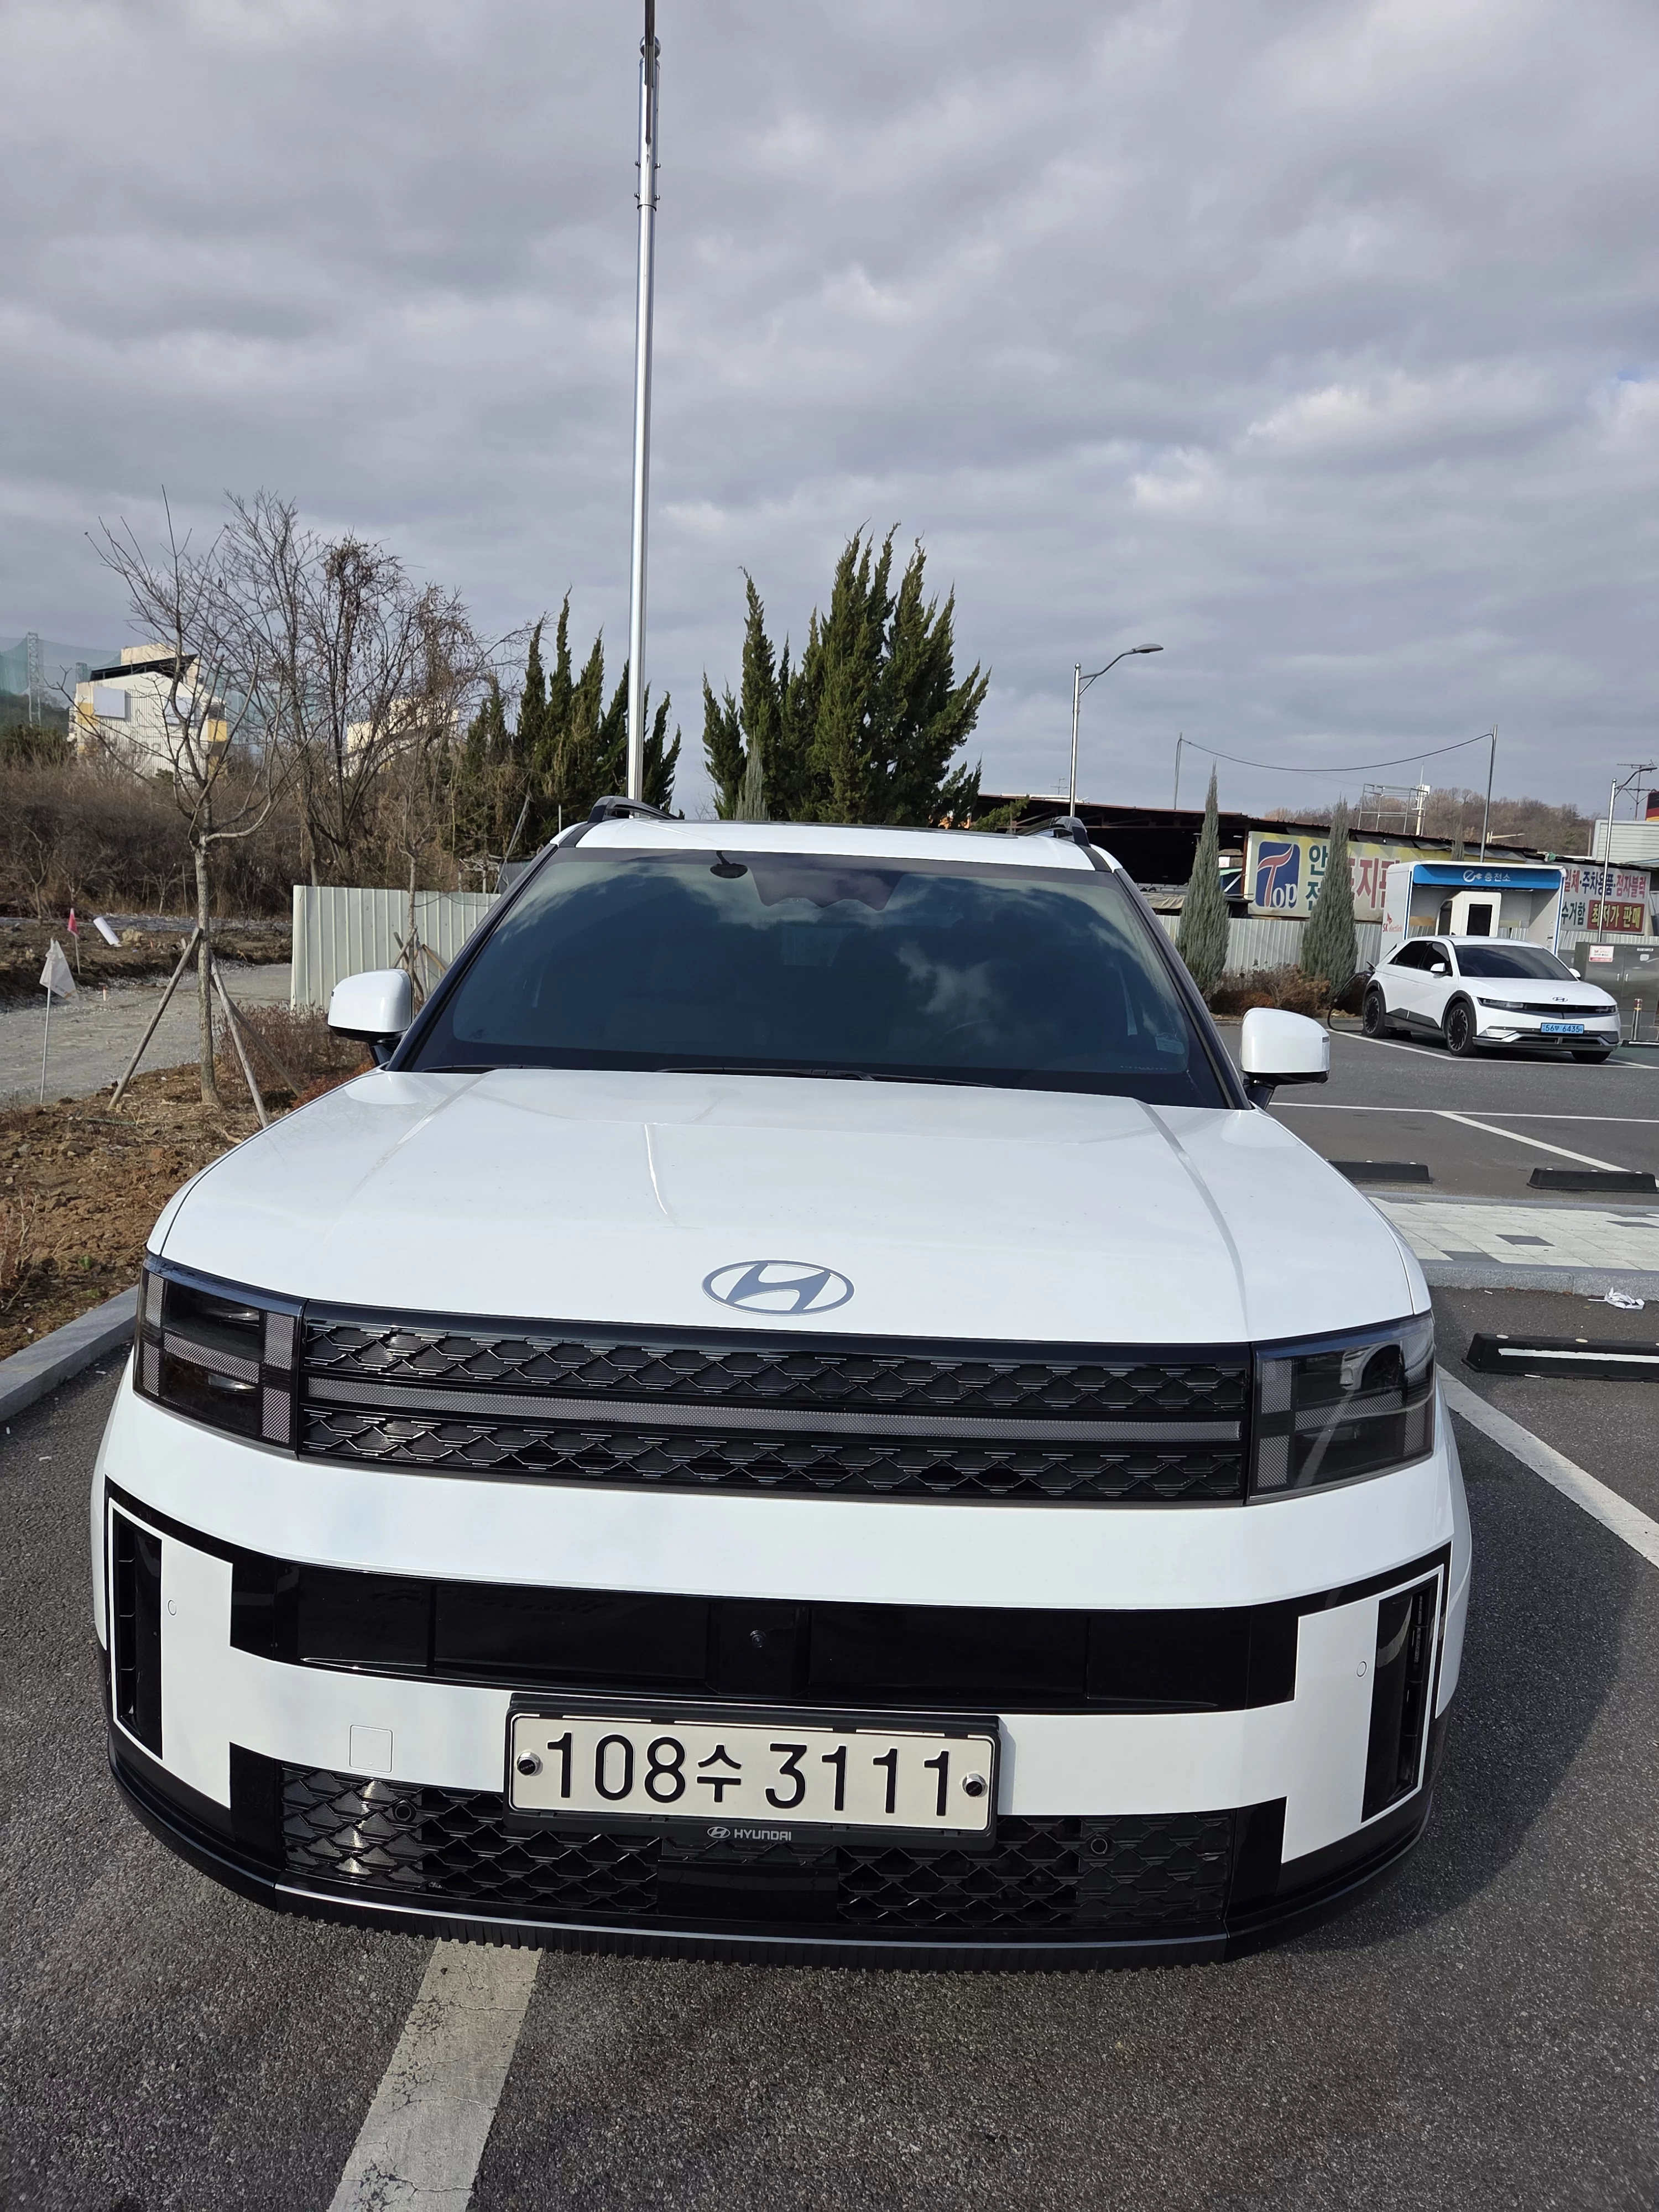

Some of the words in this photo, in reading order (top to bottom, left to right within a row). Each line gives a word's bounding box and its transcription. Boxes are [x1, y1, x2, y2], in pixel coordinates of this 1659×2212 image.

[1256, 843, 1298, 909] Top
[1484, 872, 1511, 882] 충전소
[1562, 901, 1585, 926] 수거함
[1591, 903, 1620, 928] 최저가
[1623, 906, 1642, 929] 판매
[734, 1828, 791, 1841] HYUNDAI
